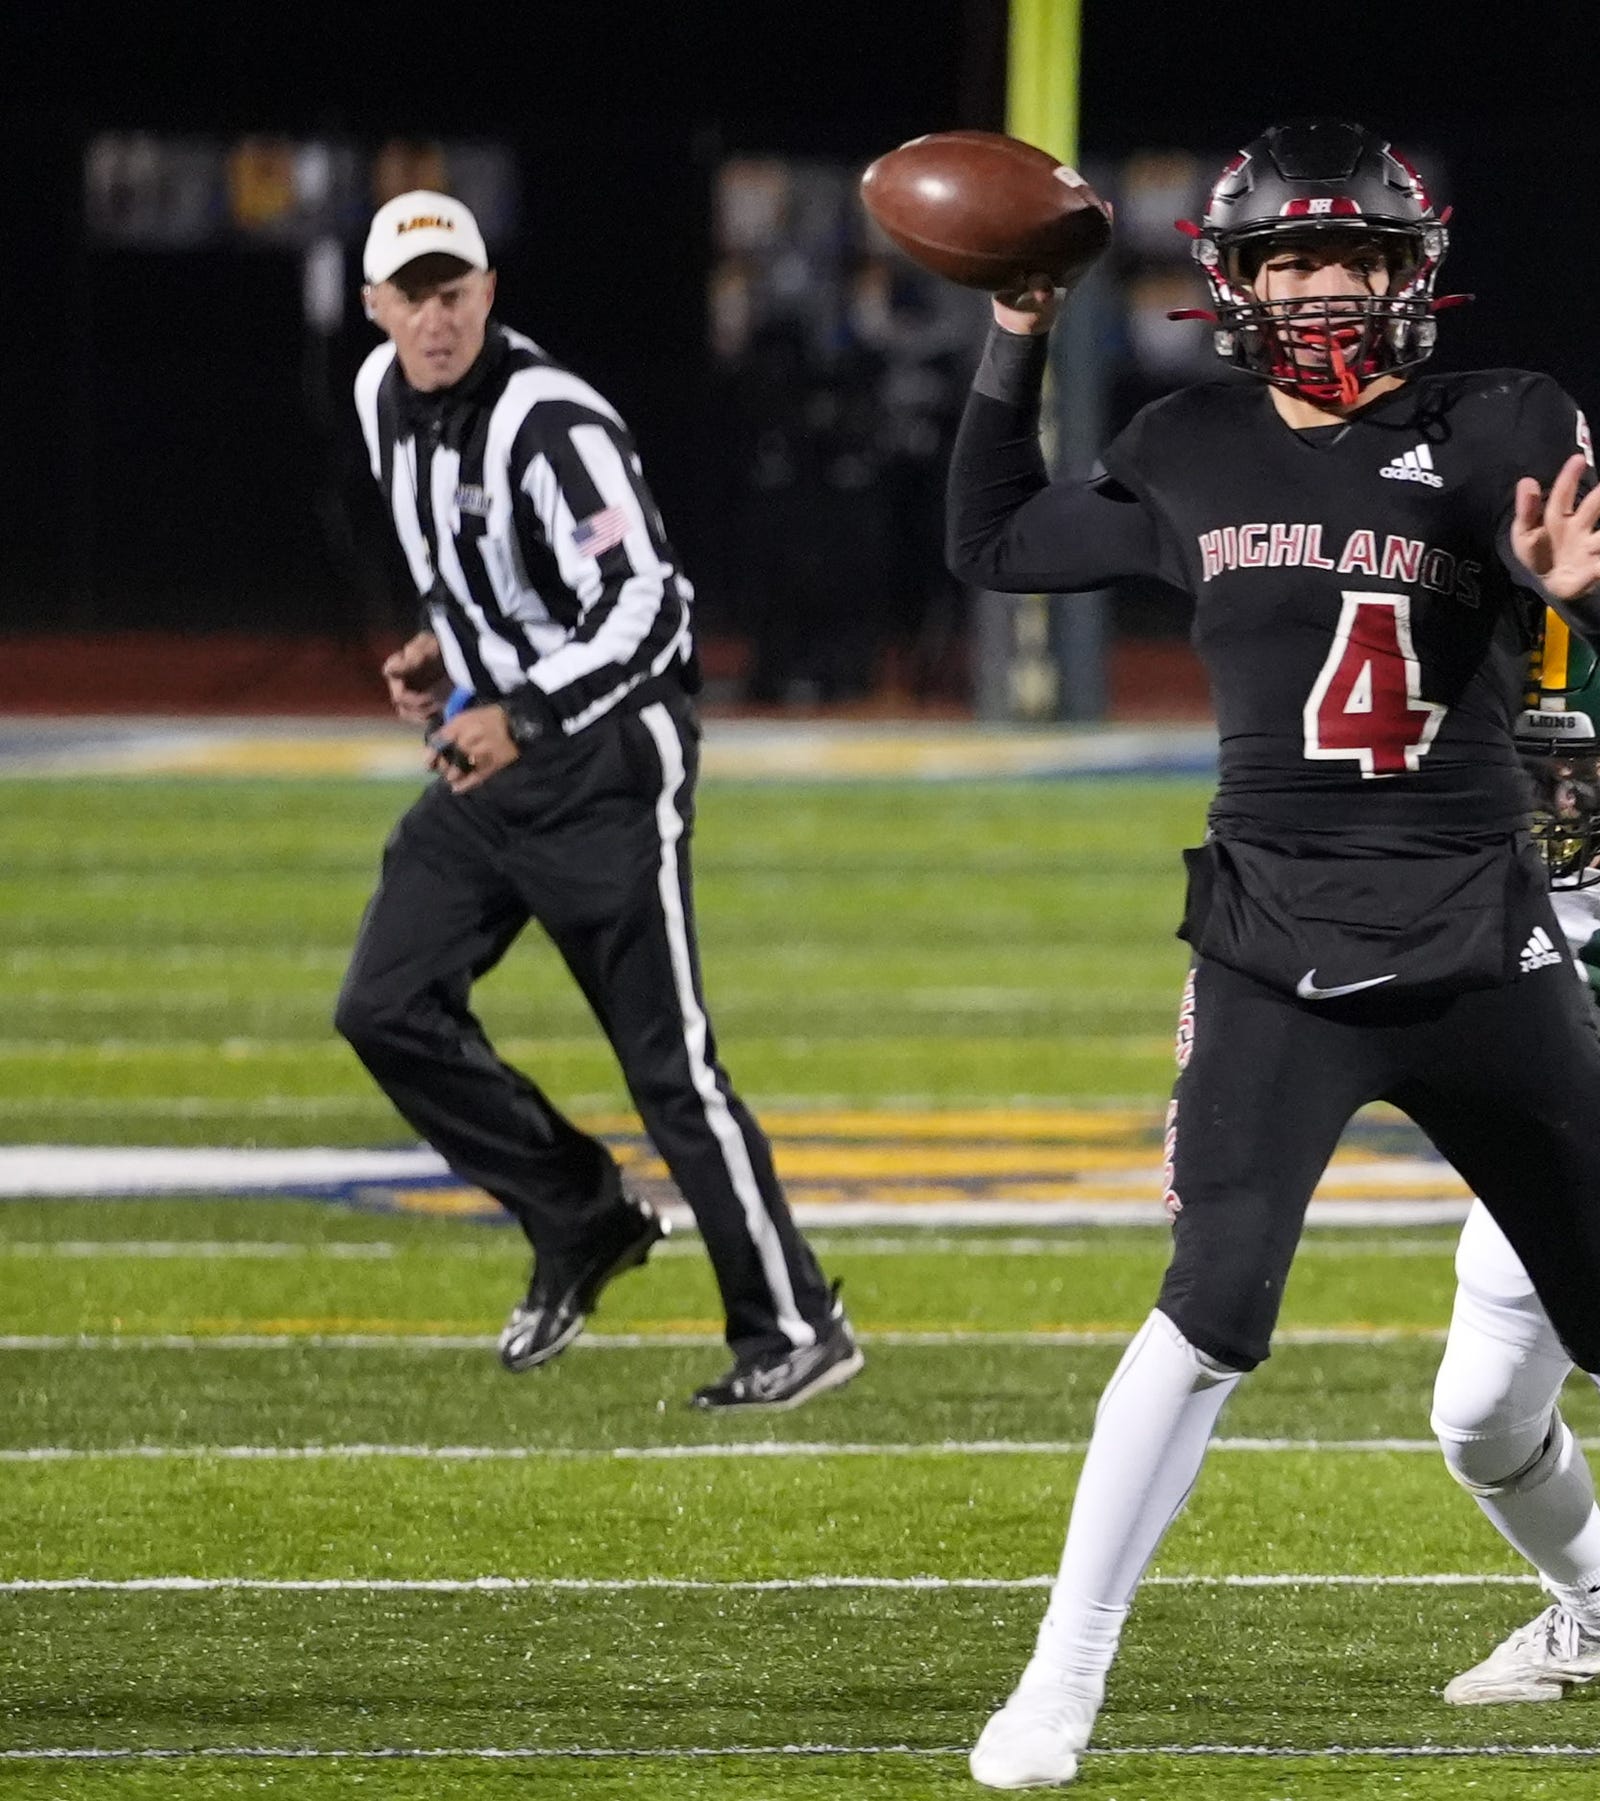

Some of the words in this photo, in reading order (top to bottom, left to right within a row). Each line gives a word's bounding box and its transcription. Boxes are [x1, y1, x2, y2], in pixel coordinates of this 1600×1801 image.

[1379, 466, 1443, 488] adidas
[1199, 524, 1480, 608] HIGHLANDS
[1303, 590, 1448, 780] 4
[1528, 715, 1576, 729] LIONS
